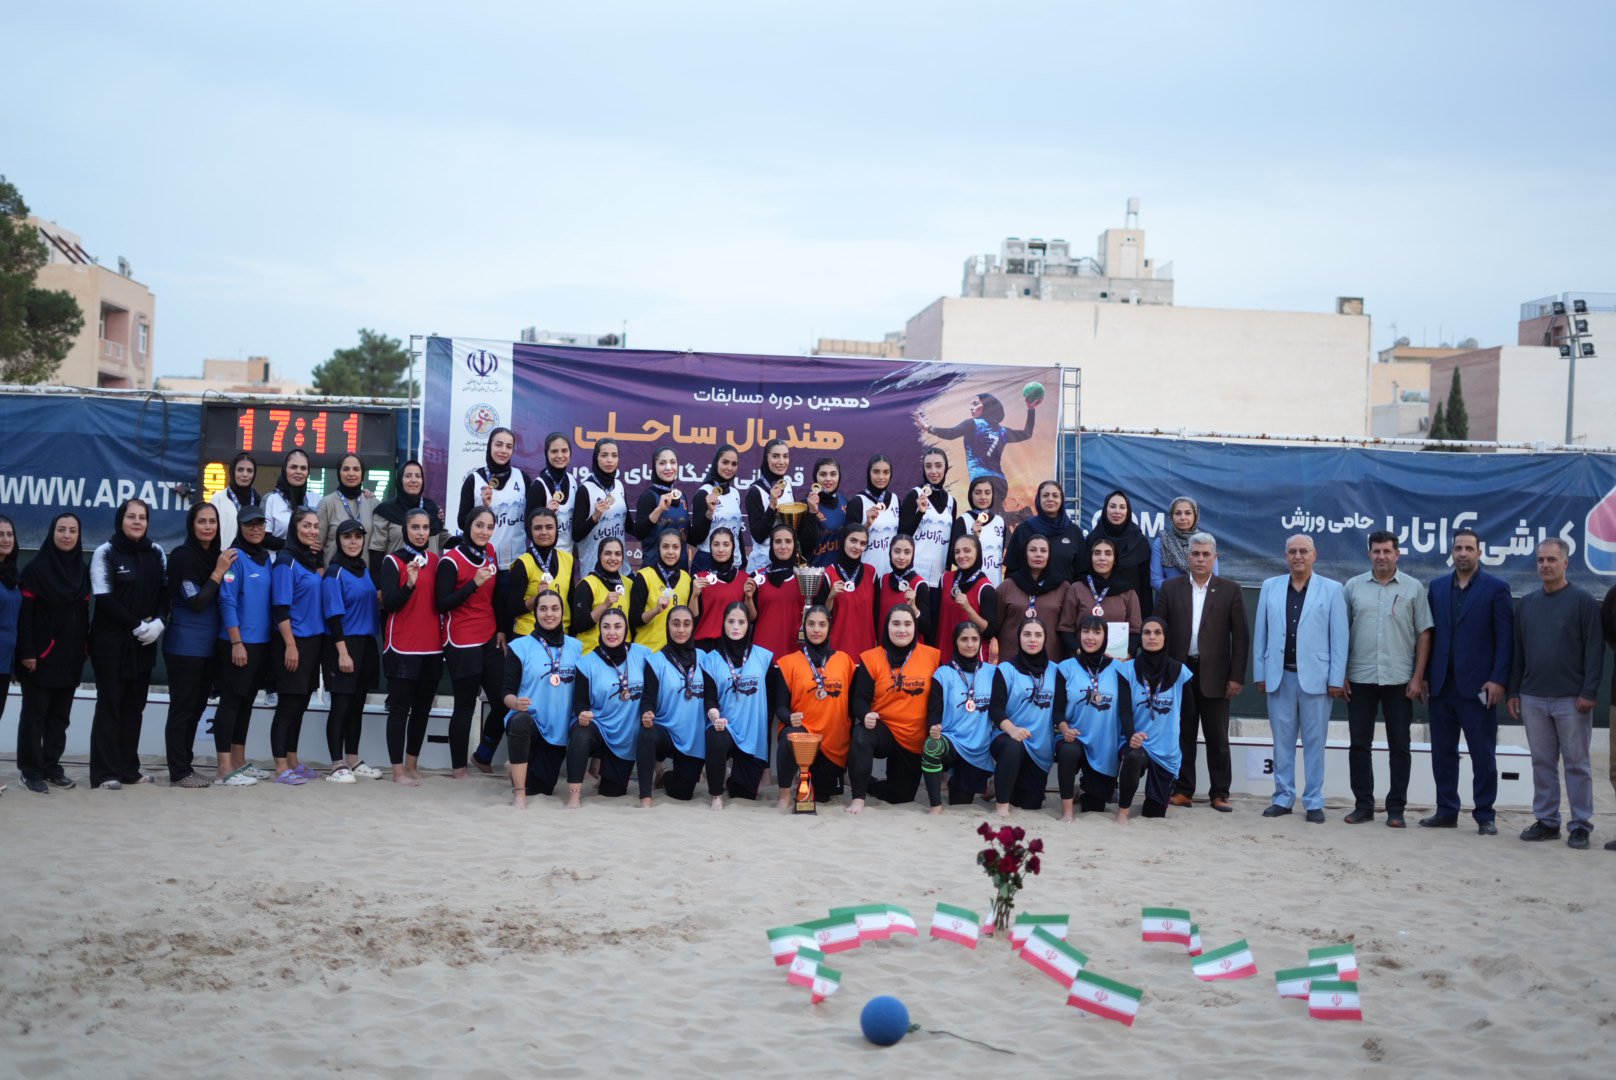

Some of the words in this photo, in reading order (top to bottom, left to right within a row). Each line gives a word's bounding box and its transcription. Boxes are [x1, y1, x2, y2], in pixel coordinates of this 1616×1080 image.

[693, 387, 764, 406] مسابقات
[768, 392, 803, 410] دوره
[808, 394, 870, 411] دهمین
[238, 408, 359, 453] 17:11
[574, 411, 717, 449] ساحلی
[1281, 506, 1326, 533] ورزش
[1327, 511, 1374, 533] حامی
[1262, 758, 1274, 775] 3
